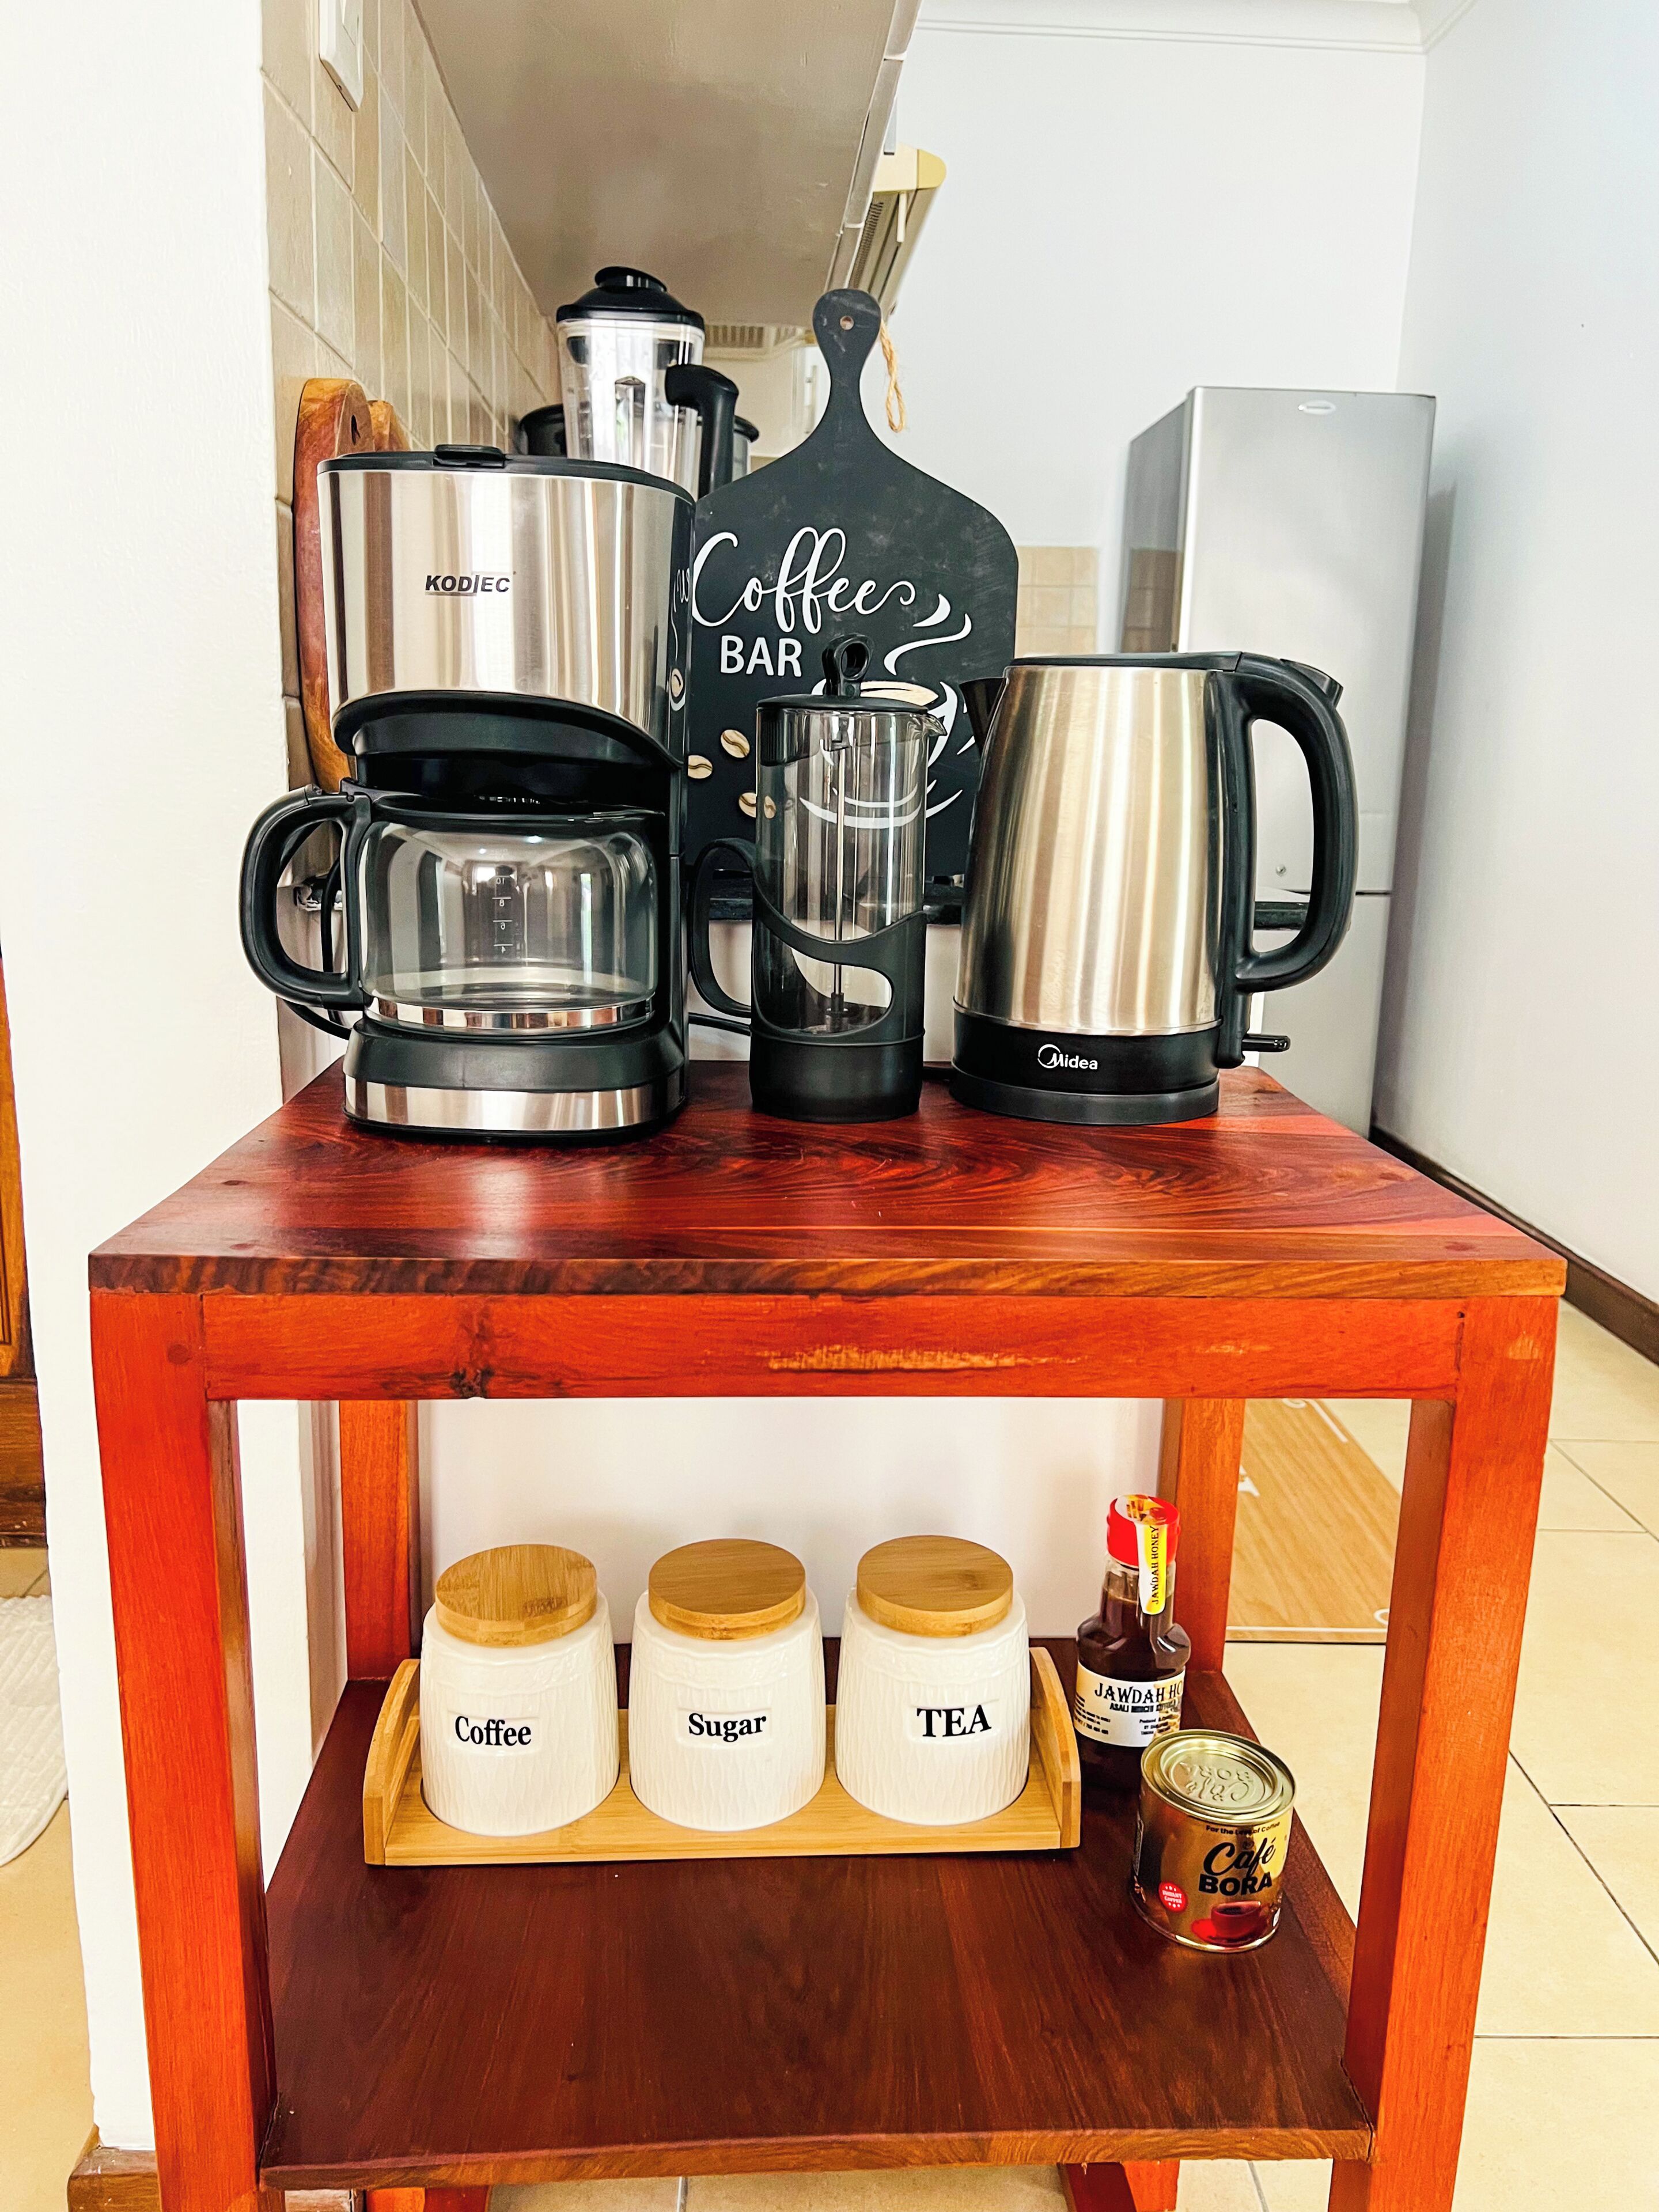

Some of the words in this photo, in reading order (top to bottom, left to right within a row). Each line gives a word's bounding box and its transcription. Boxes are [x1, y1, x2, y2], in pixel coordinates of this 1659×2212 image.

[692, 527, 916, 634] Coffee
[721, 635, 802, 677] BAR
[1037, 1044, 1098, 1070] Midea
[1150, 1525, 1159, 1559] HONEY
[1150, 1563, 1159, 1604] JAWDAH
[1094, 1682, 1165, 1703] JAWDAH
[455, 1715, 532, 1746] Coffee
[688, 1713, 767, 1742] Sugar
[917, 1705, 992, 1737] TEA
[1206, 1825, 1219, 1833] For
[1203, 1837, 1276, 1877] Café
[1199, 1872, 1272, 1896] BORA
